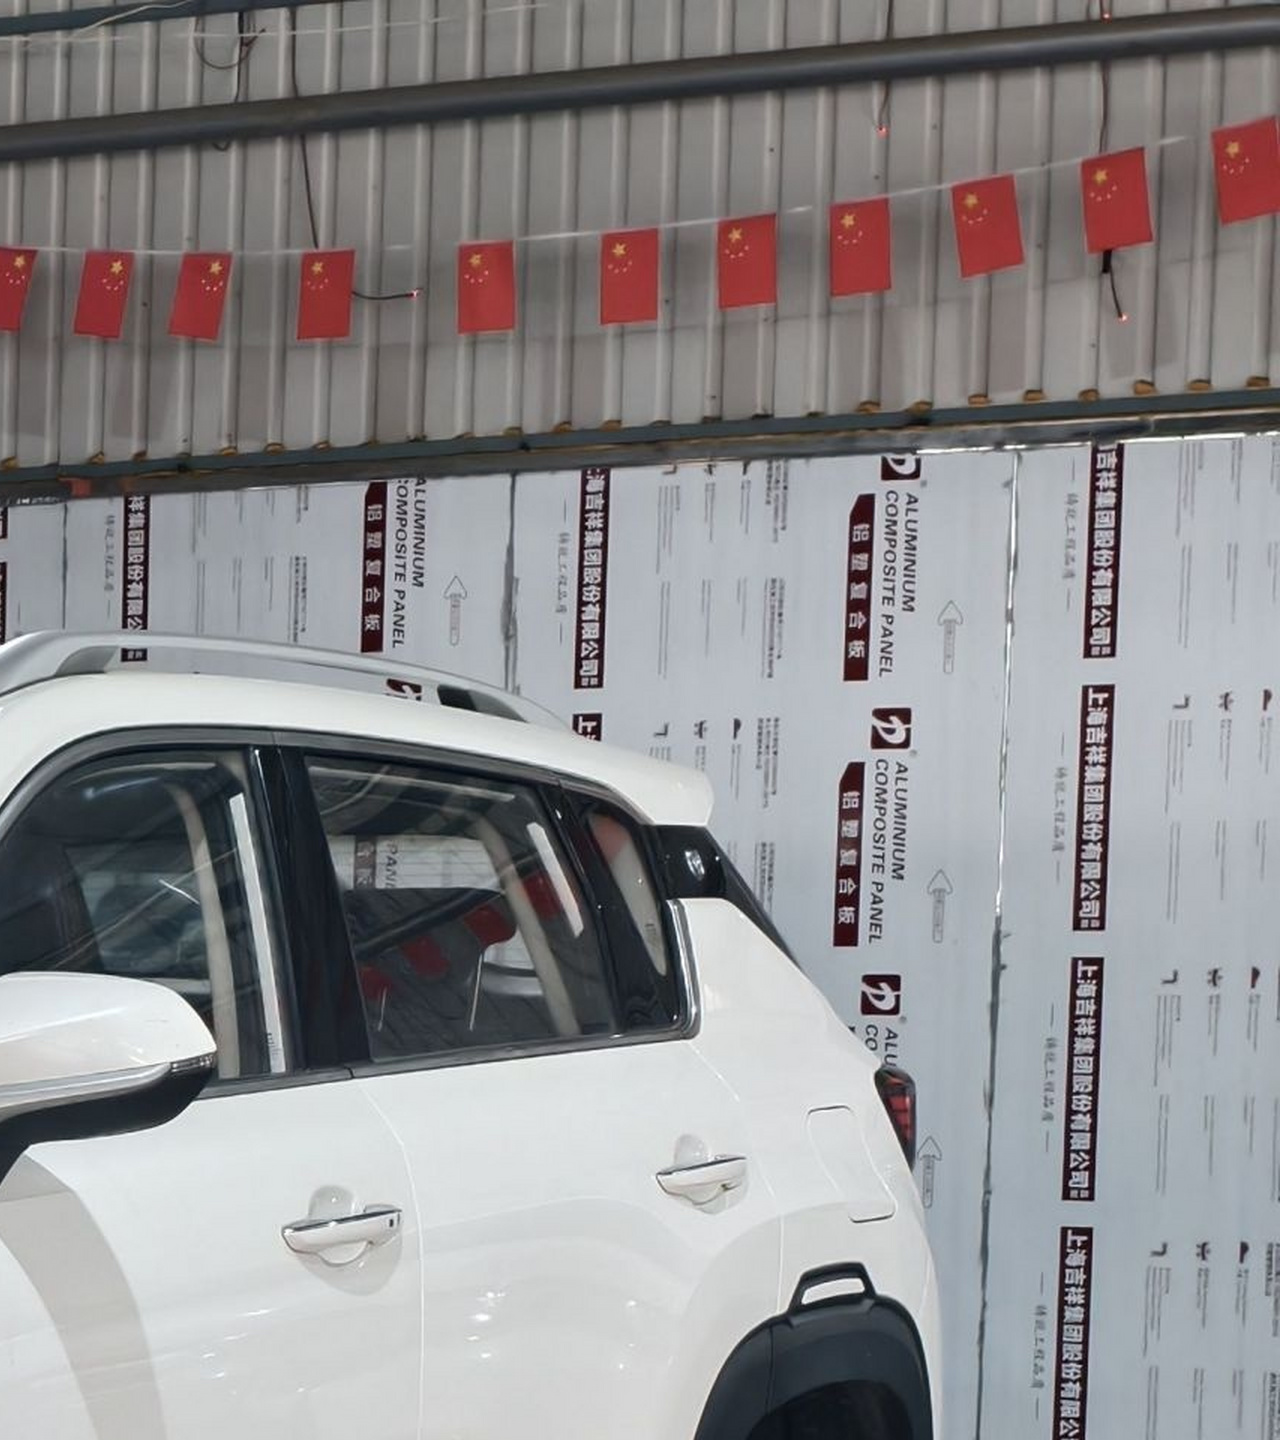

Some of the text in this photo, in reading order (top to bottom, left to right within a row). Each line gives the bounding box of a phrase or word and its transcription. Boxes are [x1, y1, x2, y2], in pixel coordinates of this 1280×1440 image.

[364, 503, 383, 633] 铝塑复合板
[411, 478, 427, 589] ALUMINIUM
[847, 522, 870, 659] 铝塑复合板
[878, 489, 900, 679] COMPOSITE PANEL
[901, 492, 919, 614] ALUMINIUM
[392, 588, 407, 650] PANEL
[837, 790, 861, 926] 铝塑复合板
[868, 758, 890, 945] COMPOSITE PANEL
[891, 761, 909, 882] ALUMINIUM
[1078, 687, 1109, 919] 上海吉祥集团股份有限公司
[1068, 959, 1100, 1189] 上海吉祥集团股份有限公司
